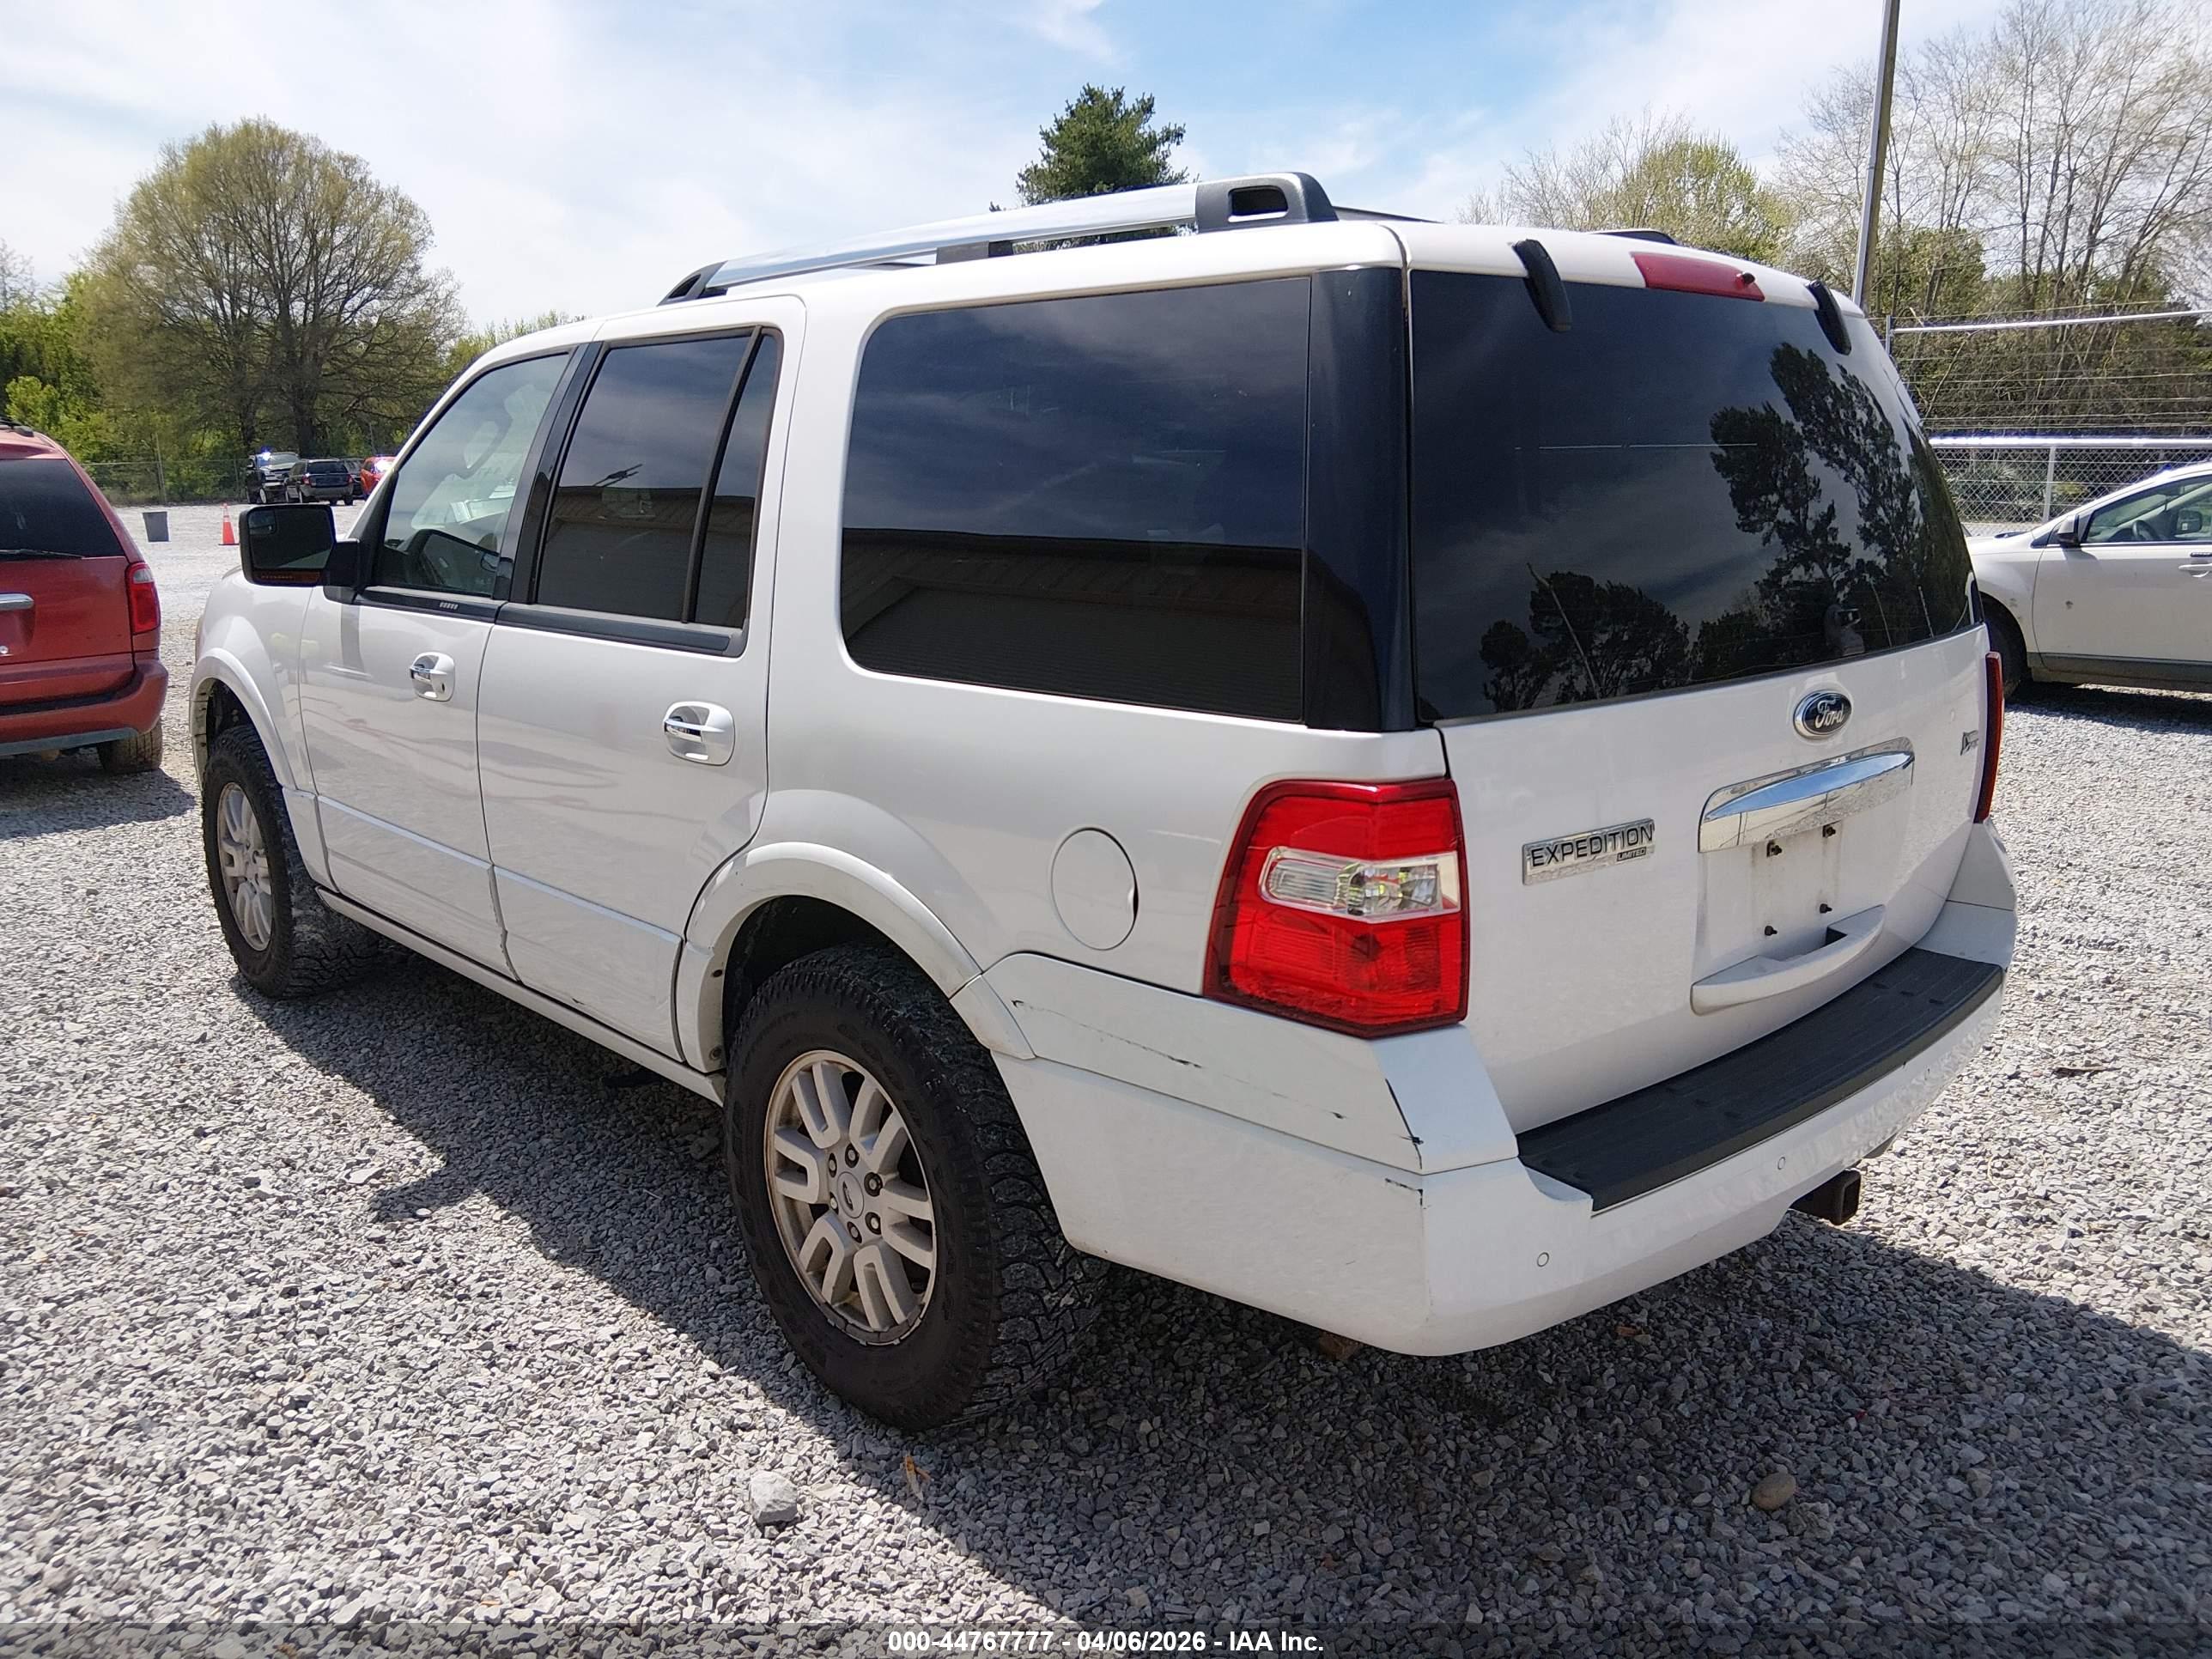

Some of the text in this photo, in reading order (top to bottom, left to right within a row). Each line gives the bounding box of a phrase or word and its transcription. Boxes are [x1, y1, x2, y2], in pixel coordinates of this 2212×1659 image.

[1814, 698, 1845, 729] Ford
[1531, 823, 1654, 867] EXPEDITION
[1617, 848, 1646, 861] LIMITED
